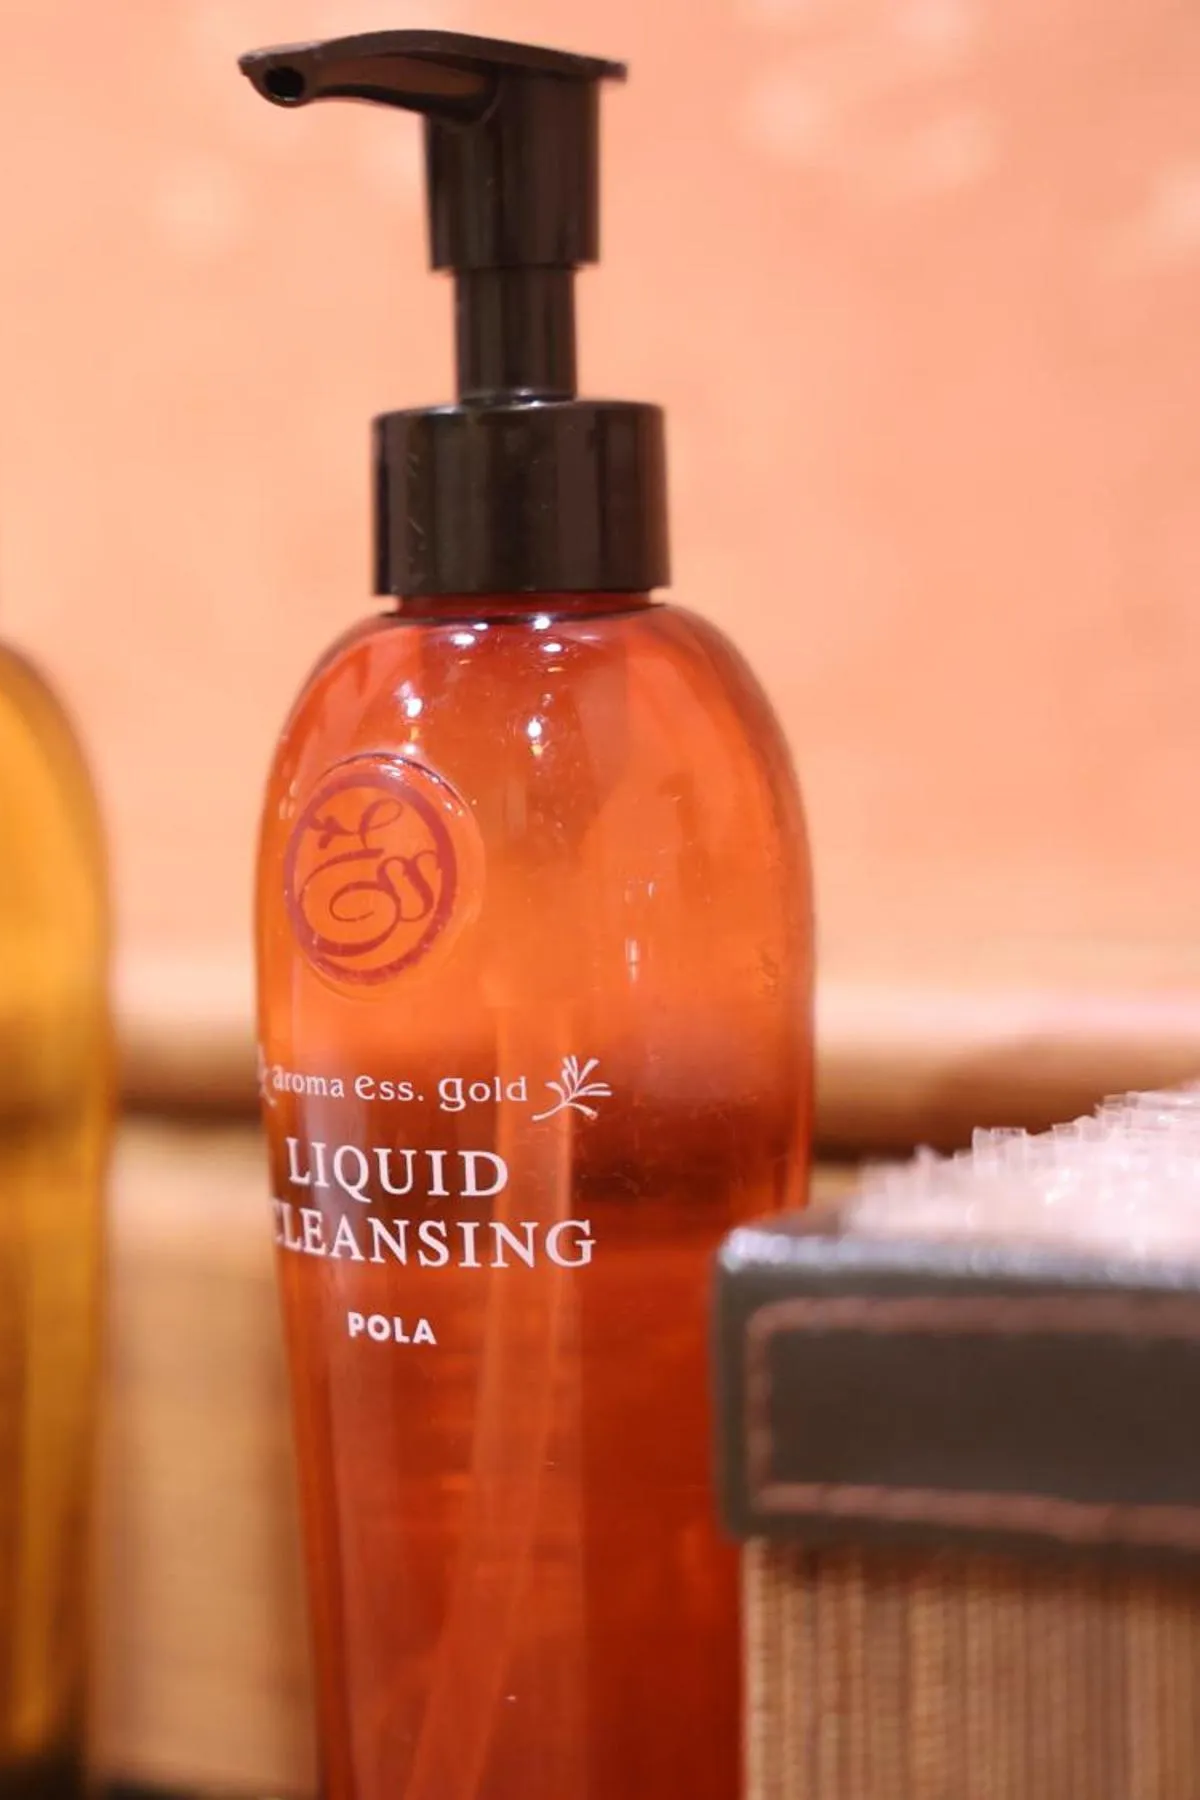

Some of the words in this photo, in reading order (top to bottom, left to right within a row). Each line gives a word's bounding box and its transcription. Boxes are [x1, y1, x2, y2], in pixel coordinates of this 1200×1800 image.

[273, 1066, 345, 1098] aroma
[354, 1075, 424, 1102] ess.
[438, 1076, 528, 1112] gold
[286, 1138, 509, 1203] LIQUID
[348, 1312, 438, 1345] POLA
